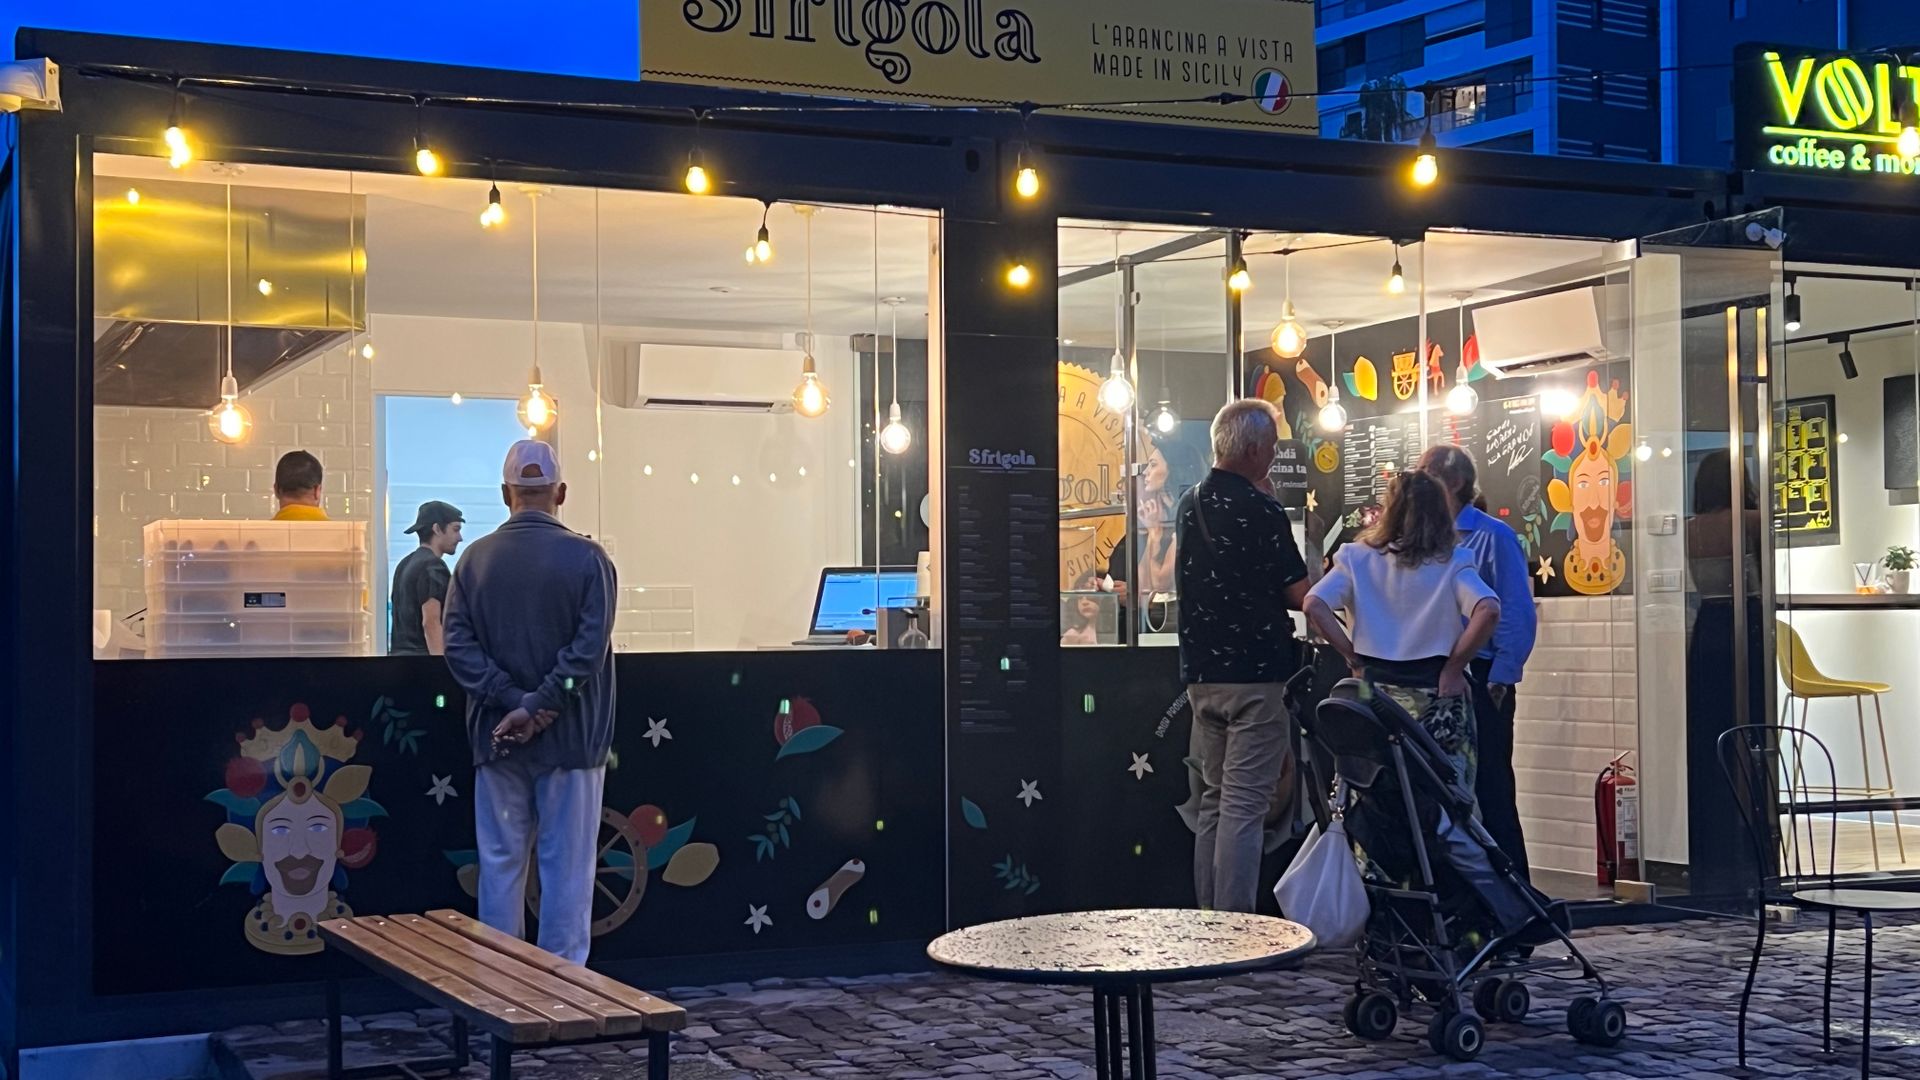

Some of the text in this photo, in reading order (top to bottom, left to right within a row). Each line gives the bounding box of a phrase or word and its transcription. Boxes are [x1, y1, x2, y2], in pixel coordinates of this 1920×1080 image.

[1092, 22, 1293, 63] L'ARANCINA A VISTA
[1093, 52, 1242, 87] MADE IN SICILY
[1769, 138, 1846, 169] coffee
[1850, 143, 1871, 171] &
[968, 448, 1037, 470] Sfrigola
